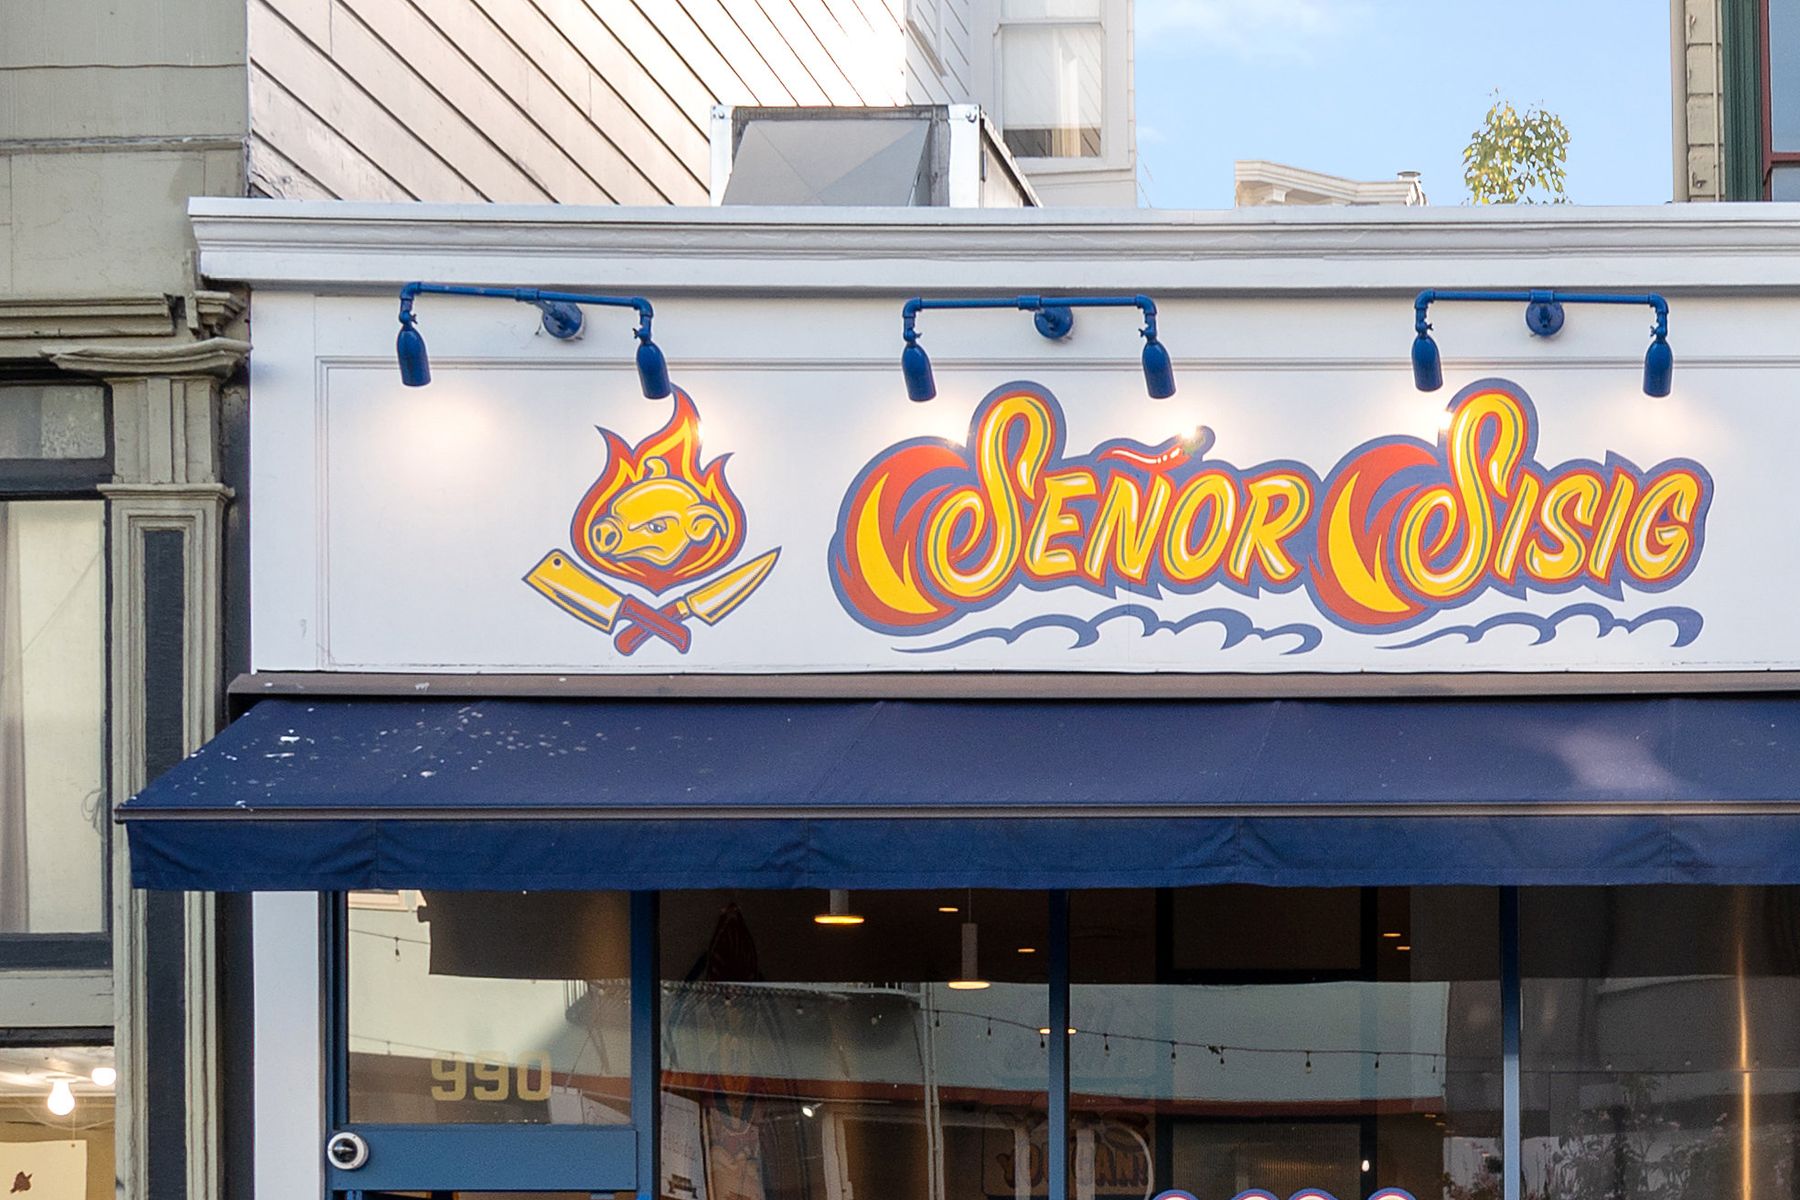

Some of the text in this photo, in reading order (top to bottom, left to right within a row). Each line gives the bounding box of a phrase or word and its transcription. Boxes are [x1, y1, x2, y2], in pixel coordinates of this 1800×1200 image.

[916, 386, 1706, 606] SEÑOR SISIG
[430, 1050, 552, 1101] 990
